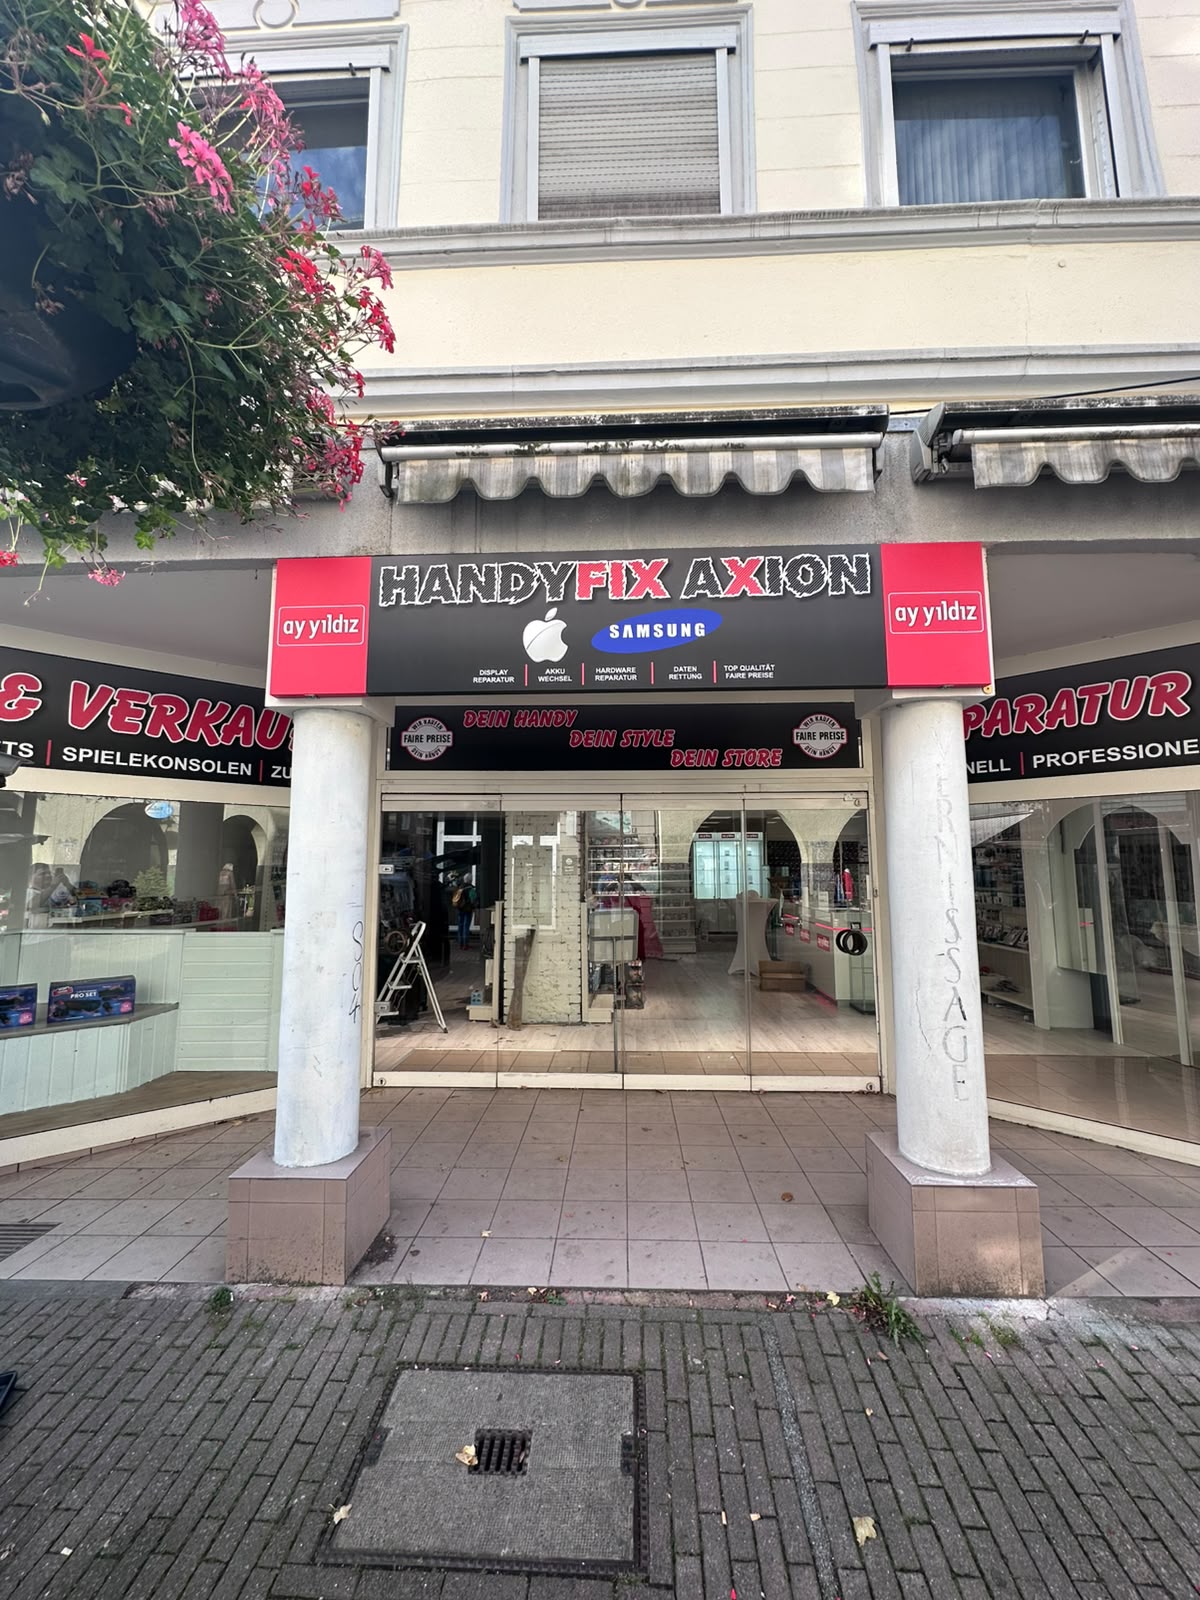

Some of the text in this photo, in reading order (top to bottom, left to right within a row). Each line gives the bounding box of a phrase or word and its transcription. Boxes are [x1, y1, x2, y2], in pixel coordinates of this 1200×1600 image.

[379, 553, 871, 606] HANDYFIX AXION
[895, 606, 919, 627] ay
[283, 620, 306, 640] ay
[609, 622, 706, 639] SAMSUNG
[479, 669, 509, 677] DISPLAY
[545, 668, 566, 676] AKKU
[595, 666, 637, 675] HARDWARE
[673, 665, 698, 673] DATEN
[723, 663, 776, 672] TOP QUALITÄT
[473, 676, 515, 684] REPARATUR
[538, 675, 573, 683] WECHSEL
[594, 674, 638, 682] REPARATUR
[668, 672, 703, 680] RETTUNG
[725, 671, 774, 680] FAIRE PREISE
[0, 671, 43, 723] &
[962, 670, 1192, 742] PARATUR
[67, 680, 294, 751] VERKAU
[463, 709, 579, 728] DEIN HANDY
[403, 734, 451, 743] FAIRE PREISE
[569, 729, 676, 748] DEIN STYLE
[795, 731, 845, 741] FAIRE PREISE
[0, 740, 35, 758] TS
[1032, 738, 1199, 769] PROFESSIONE
[61, 746, 253, 777] SPIELEKONSOLEN
[670, 748, 784, 768] DEIN STORE
[70, 991, 84, 999] PRO
